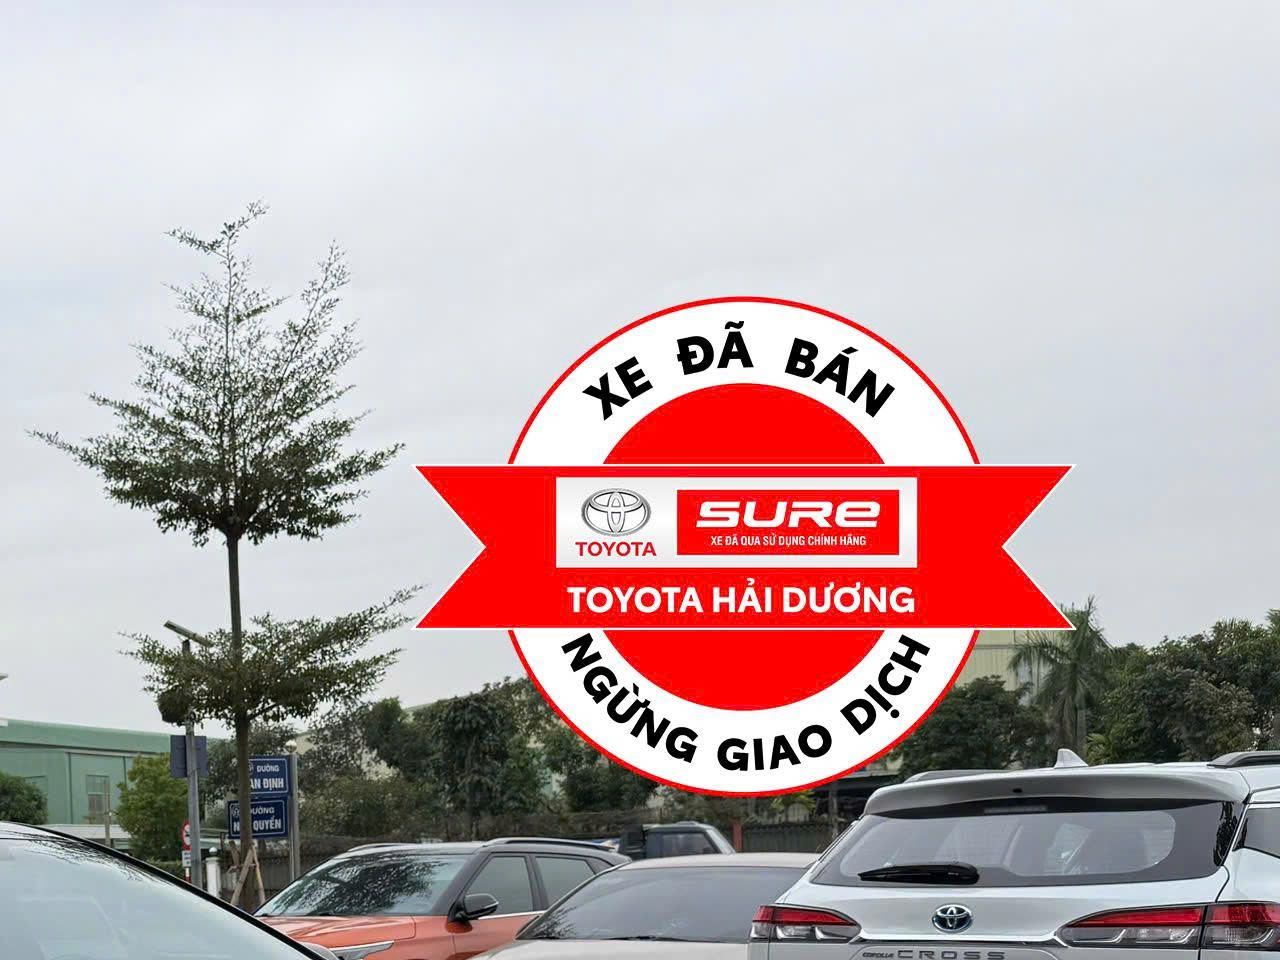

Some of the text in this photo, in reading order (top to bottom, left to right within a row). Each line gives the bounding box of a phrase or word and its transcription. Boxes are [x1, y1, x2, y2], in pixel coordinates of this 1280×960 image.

[262, 778, 284, 791] ĐỊNH
[250, 805, 275, 815] ƯỜNG
[897, 950, 1006, 960] CROSS
